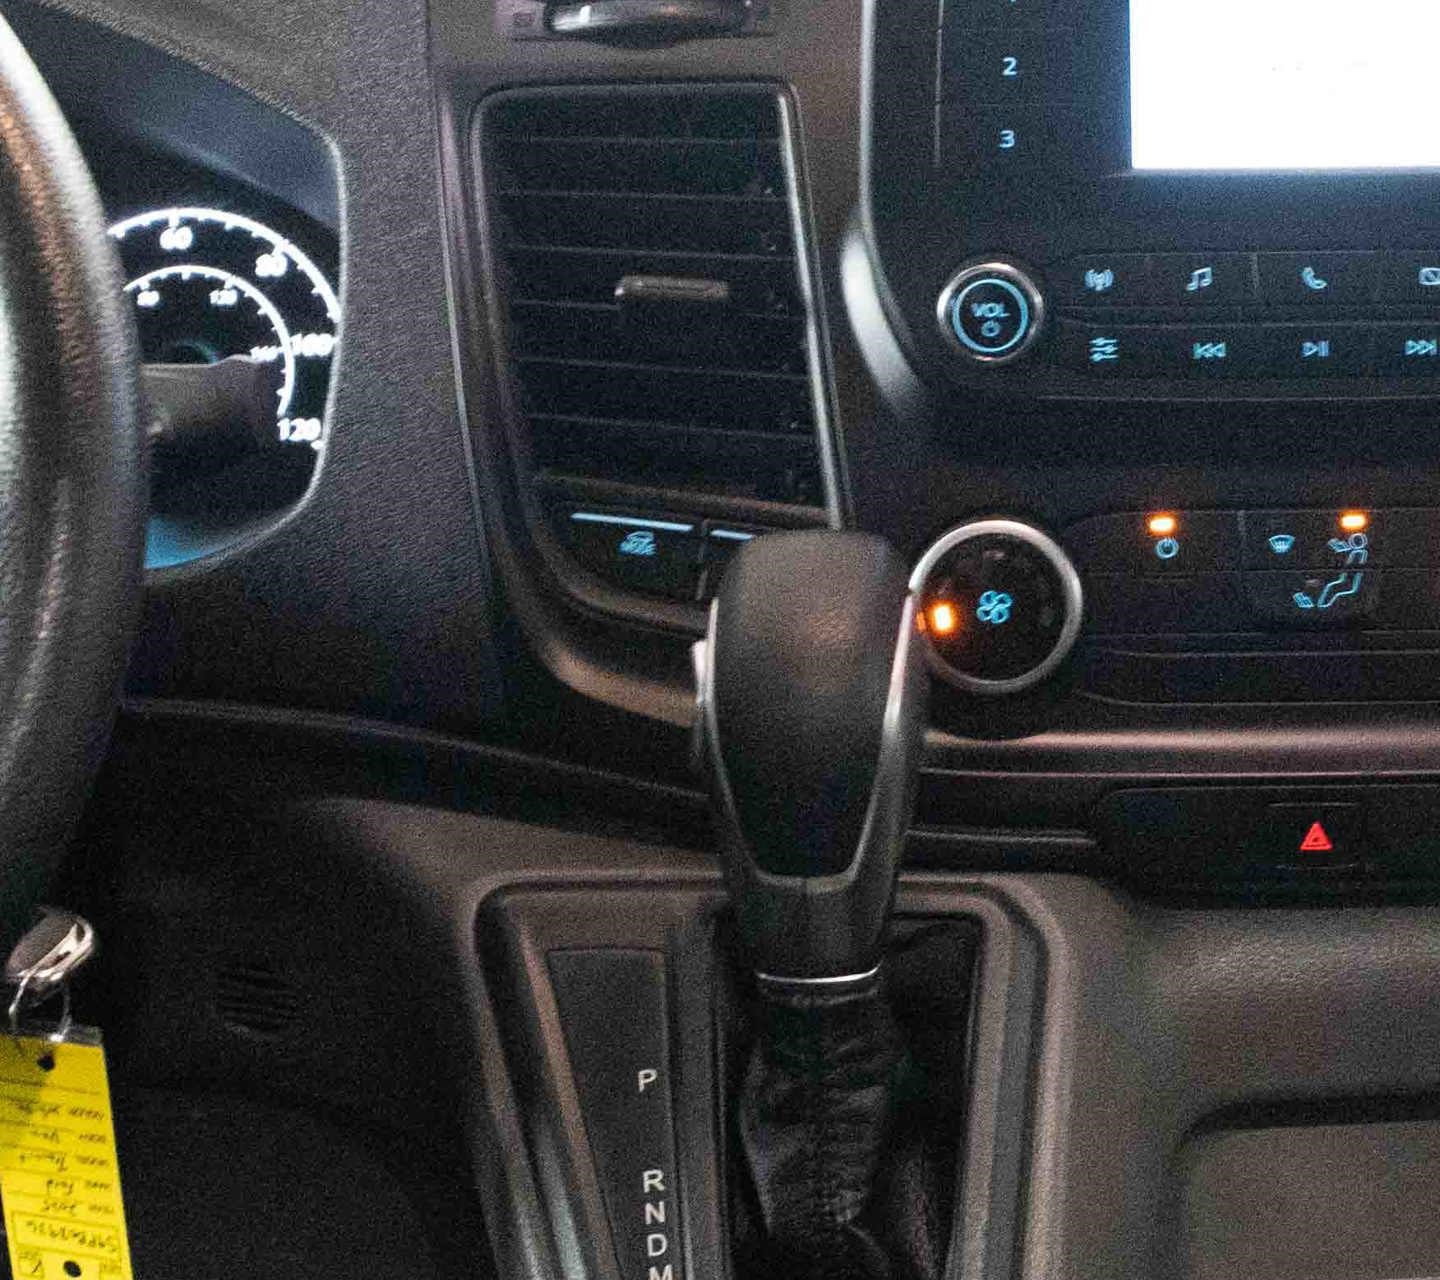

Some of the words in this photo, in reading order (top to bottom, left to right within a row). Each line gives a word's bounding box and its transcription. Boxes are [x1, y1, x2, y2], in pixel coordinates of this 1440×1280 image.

[1002, 56, 1018, 77] 2
[999, 129, 1016, 149] 3
[160, 226, 193, 250] 60
[255, 253, 288, 278] 80
[970, 302, 1011, 318] VOL
[277, 417, 322, 442] 120
[637, 1069, 658, 1093] P
[643, 1169, 666, 1192] R
[644, 1201, 667, 1224] N
[647, 1233, 667, 1257] D
